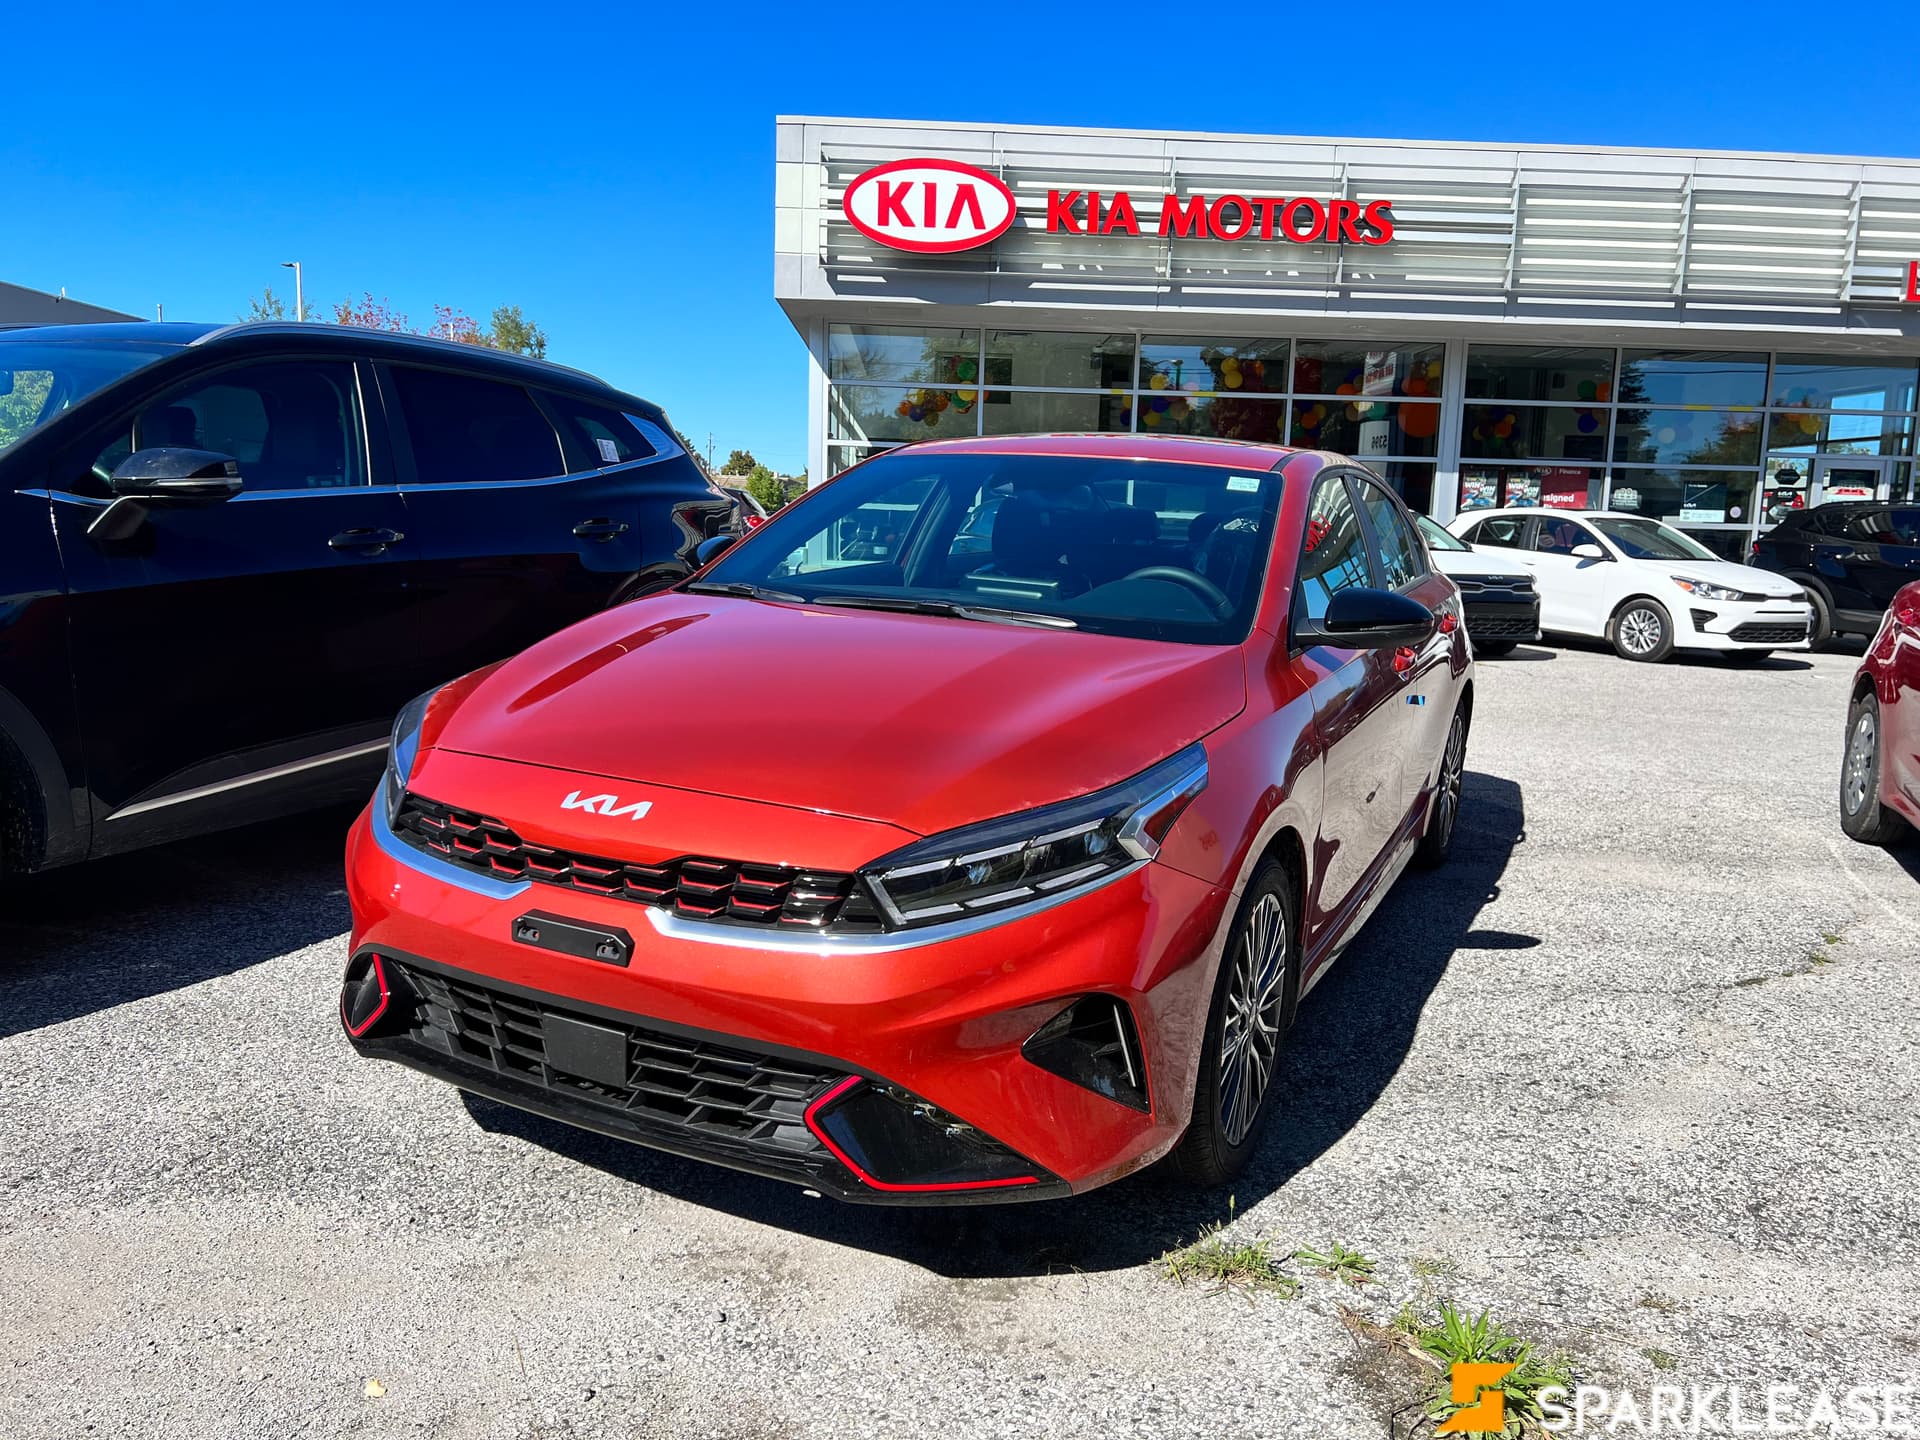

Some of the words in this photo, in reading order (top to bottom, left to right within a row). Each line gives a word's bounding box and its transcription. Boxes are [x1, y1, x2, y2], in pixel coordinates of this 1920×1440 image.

[876, 180, 987, 230] KIA
[1046, 189, 1140, 236] KIA
[1158, 194, 1395, 246] MOTORS
[559, 789, 654, 821] KIA
